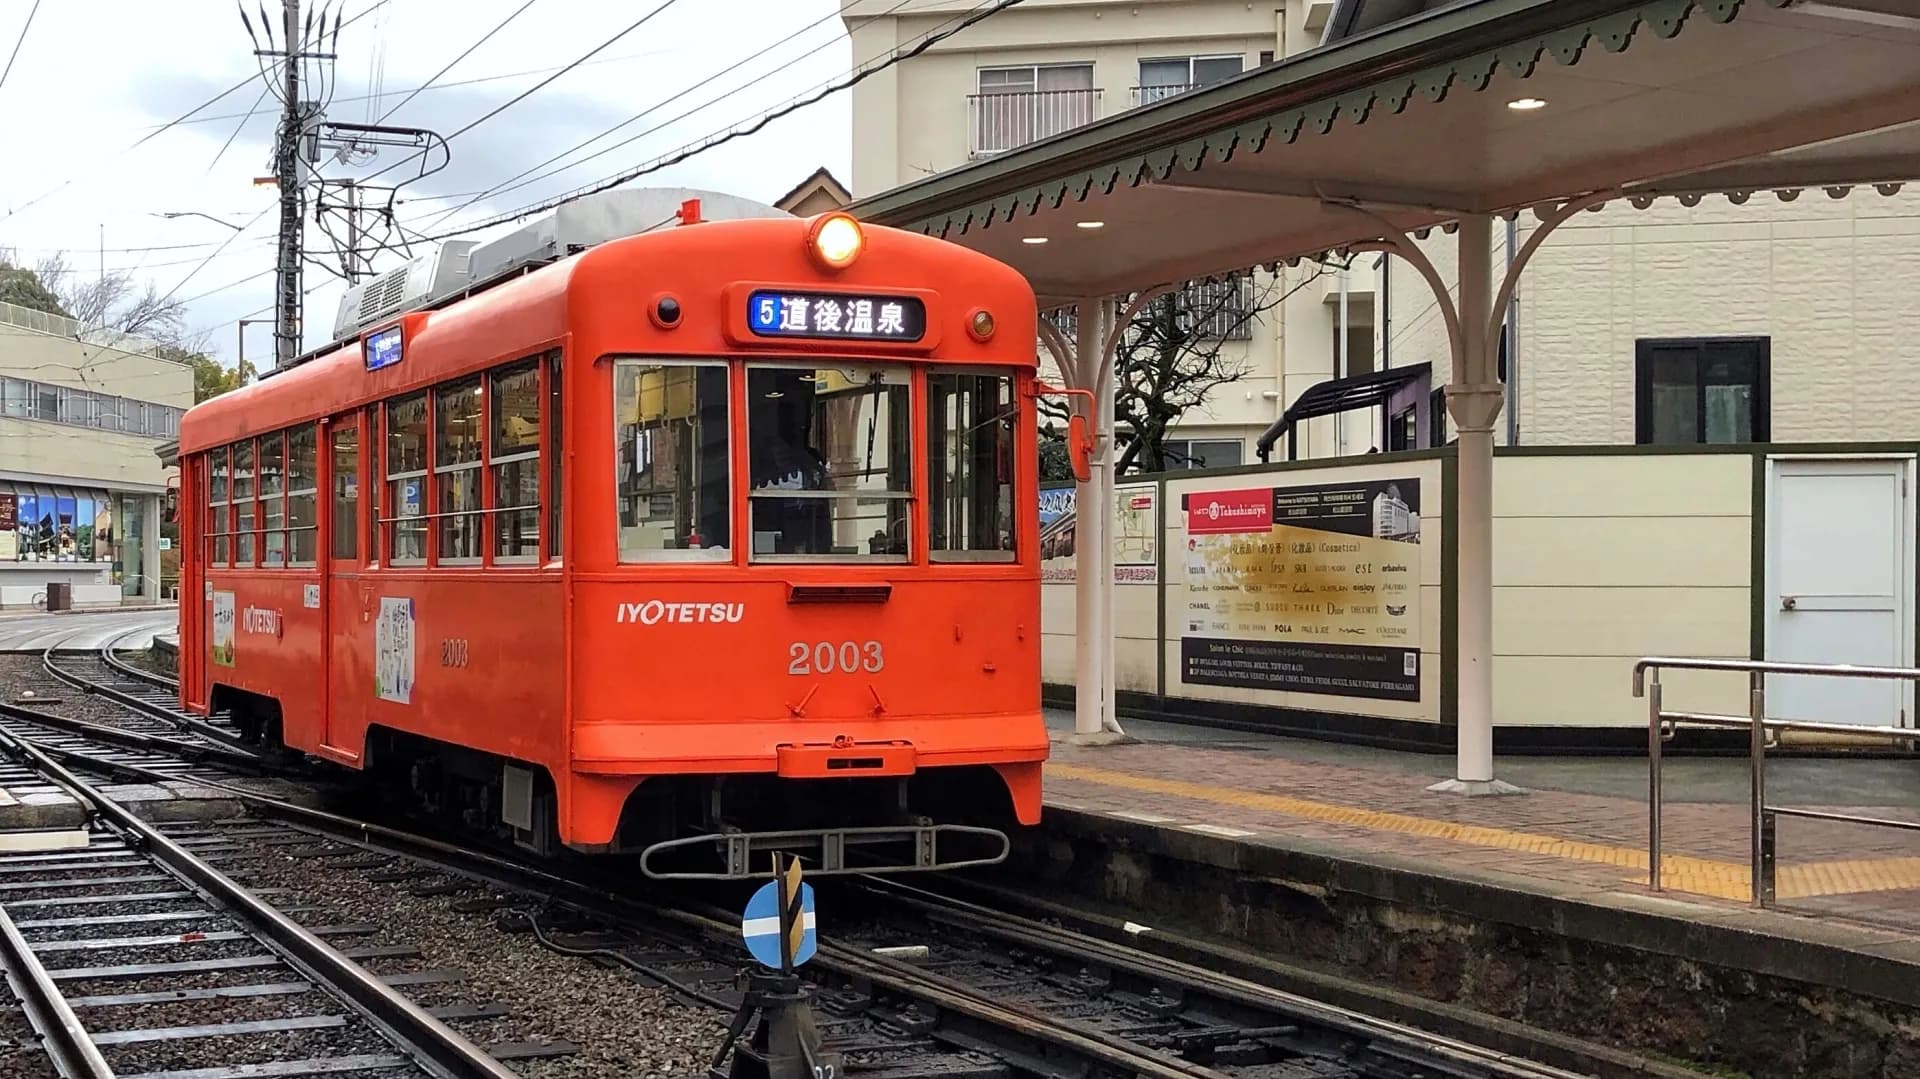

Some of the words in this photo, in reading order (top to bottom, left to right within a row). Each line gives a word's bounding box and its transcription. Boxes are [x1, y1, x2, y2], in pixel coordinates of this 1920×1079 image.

[760, 300, 775, 325] 5
[780, 297, 905, 334] 道後温泉
[1219, 504, 1266, 518] Takashimaya
[1355, 563, 1372, 574] est
[1353, 584, 1376, 593] sisley
[616, 599, 744, 625] IYOTETSU
[1189, 602, 1210, 610] CHANEL
[1327, 602, 1344, 615] Dior
[242, 604, 276, 634] IYOTETSU
[1274, 624, 1292, 633] POLA
[441, 638, 468, 668] 2003
[788, 641, 884, 675] 2003
